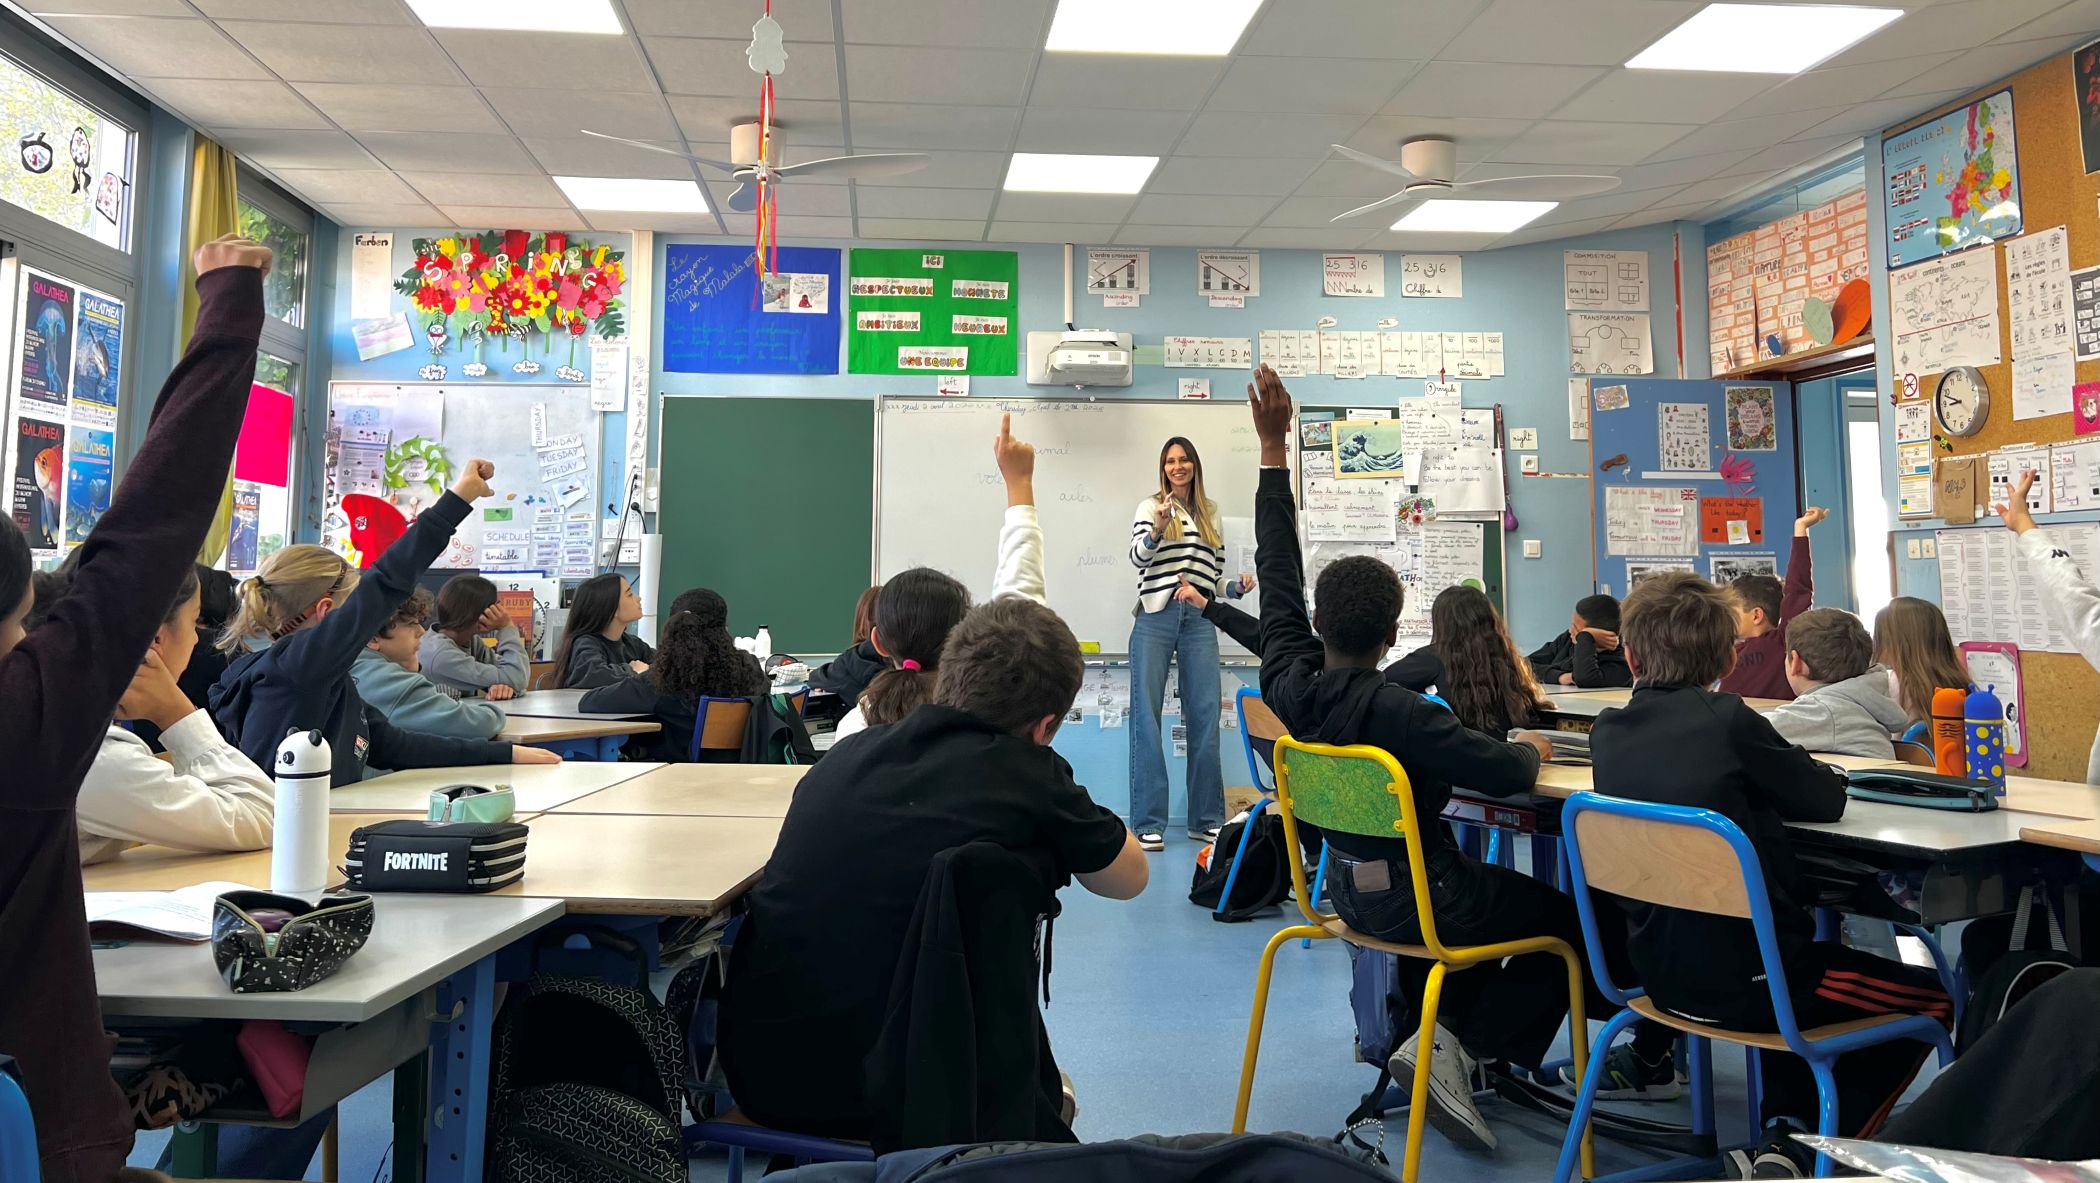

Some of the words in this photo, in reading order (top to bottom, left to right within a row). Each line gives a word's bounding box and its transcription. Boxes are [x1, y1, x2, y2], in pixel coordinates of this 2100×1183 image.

[355, 237, 389, 248] Farben
[1574, 252, 1617, 260] COMPOSITION
[1325, 260, 1340, 270] 25
[1404, 262, 1420, 273] 25
[703, 261, 745, 299] Malala
[33, 281, 69, 303] GALATHEA
[851, 284, 933, 296] RESPECTUEUX
[953, 287, 1006, 299] HONNETE
[1405, 283, 1431, 296] Chiffre
[1105, 294, 1133, 303] Ascending
[1211, 294, 1243, 304] Descending
[84, 298, 120, 319] GALATHEA
[1579, 314, 1635, 322] TRANSFORMATION
[953, 322, 1006, 334] HEUREUX
[1178, 348, 1185, 356] V
[1231, 349, 1238, 357] D
[900, 356, 923, 367] UNE
[1956, 374, 1962, 382] 12
[1184, 380, 1200, 394] right
[1946, 411, 1951, 420] 8
[22, 422, 60, 441] GALATHEA
[546, 436, 578, 448] ONDAY
[1512, 430, 1533, 448] right
[73, 440, 111, 458] GALATHEA
[541, 448, 578, 464] TUESDAY
[1444, 463, 1457, 471] best
[1608, 518, 1626, 528] Today
[1651, 519, 1680, 527] THURSDAY
[487, 532, 530, 542] SCHEDULE
[508, 583, 519, 591] 12
[383, 851, 448, 872] FORTNITE
